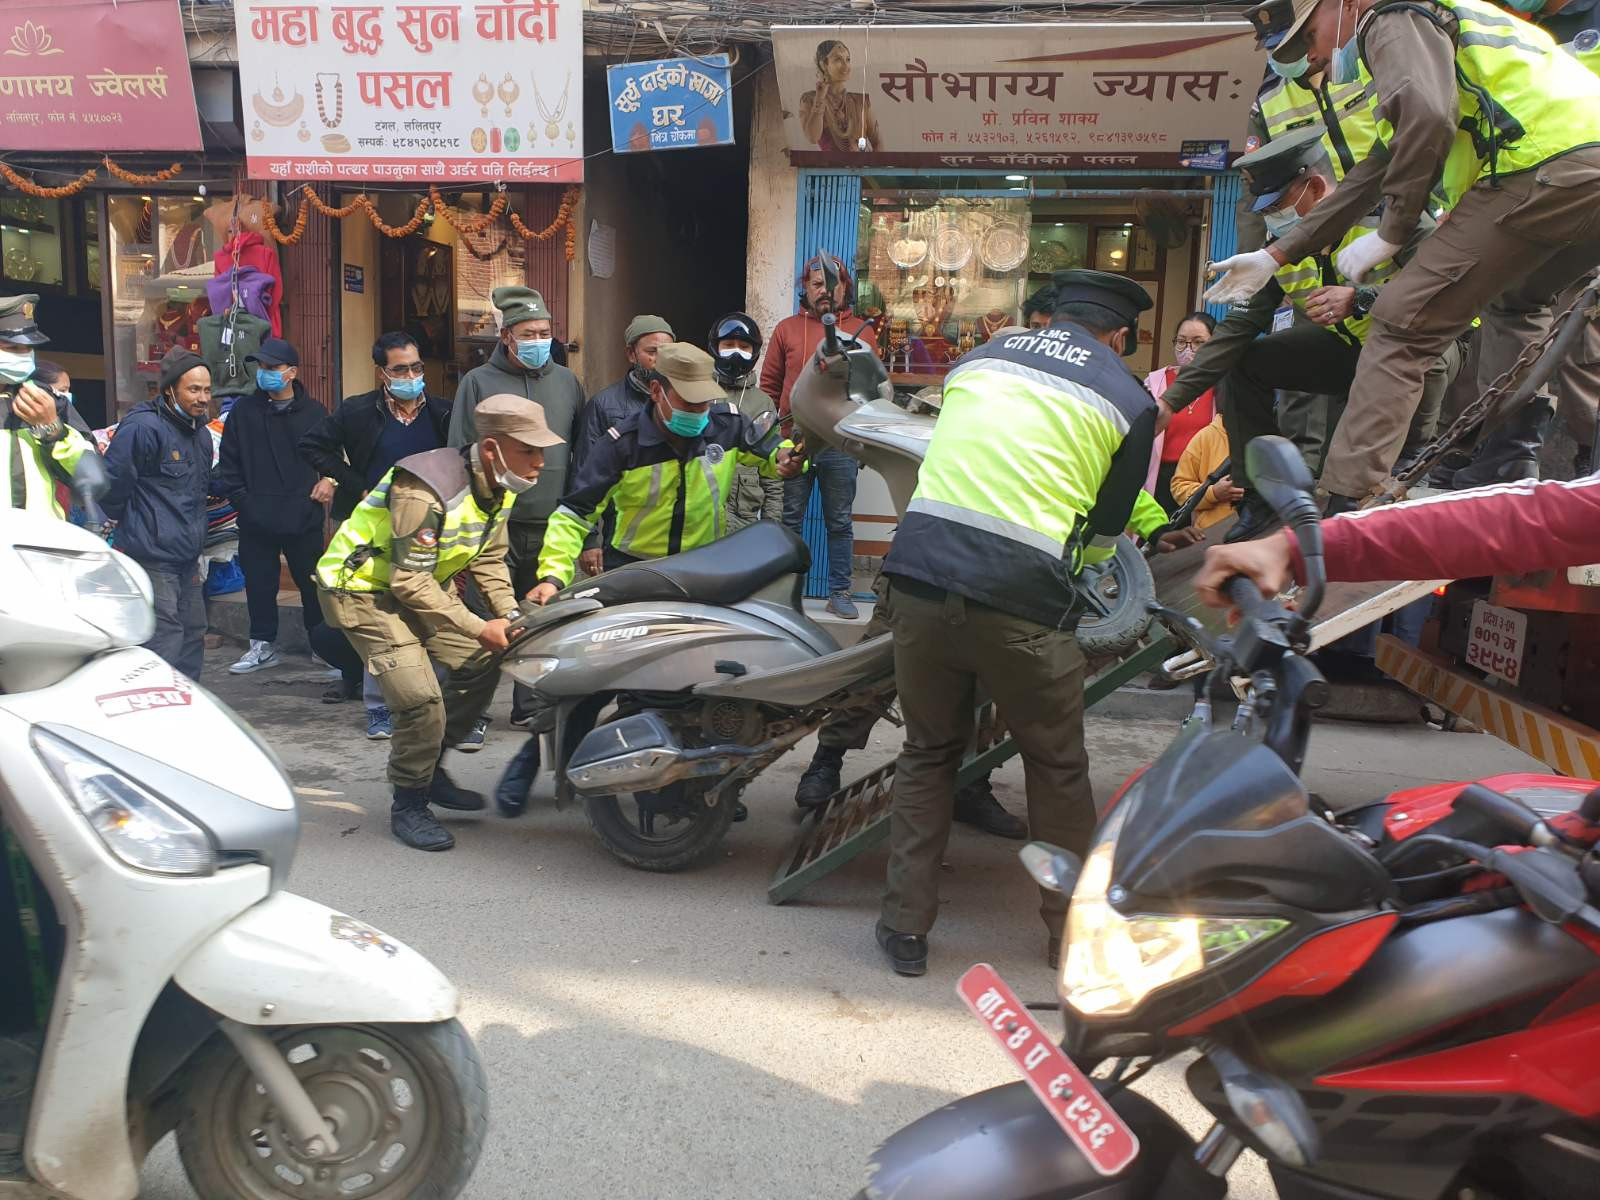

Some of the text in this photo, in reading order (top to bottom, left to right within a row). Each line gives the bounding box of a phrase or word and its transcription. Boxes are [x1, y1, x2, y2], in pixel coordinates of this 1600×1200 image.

[249, 6, 319, 46] महा
[331, 6, 384, 55] बुद्ध
[396, 5, 461, 53] सुन
[86, 66, 168, 99] ज्वेलर्स
[356, 72, 452, 110] पसल
[879, 57, 1064, 103] सौभाग्य
[652, 105, 685, 127] घर
[1059, 113, 1100, 126] शाक्य
[270, 160, 292, 176] यहाँ
[420, 161, 446, 176] साथै
[481, 161, 504, 176] पनि
[1082, 156, 1138, 165] पसल
[1037, 329, 1071, 341] LMC
[1003, 335, 1092, 367] CITY POLICE
